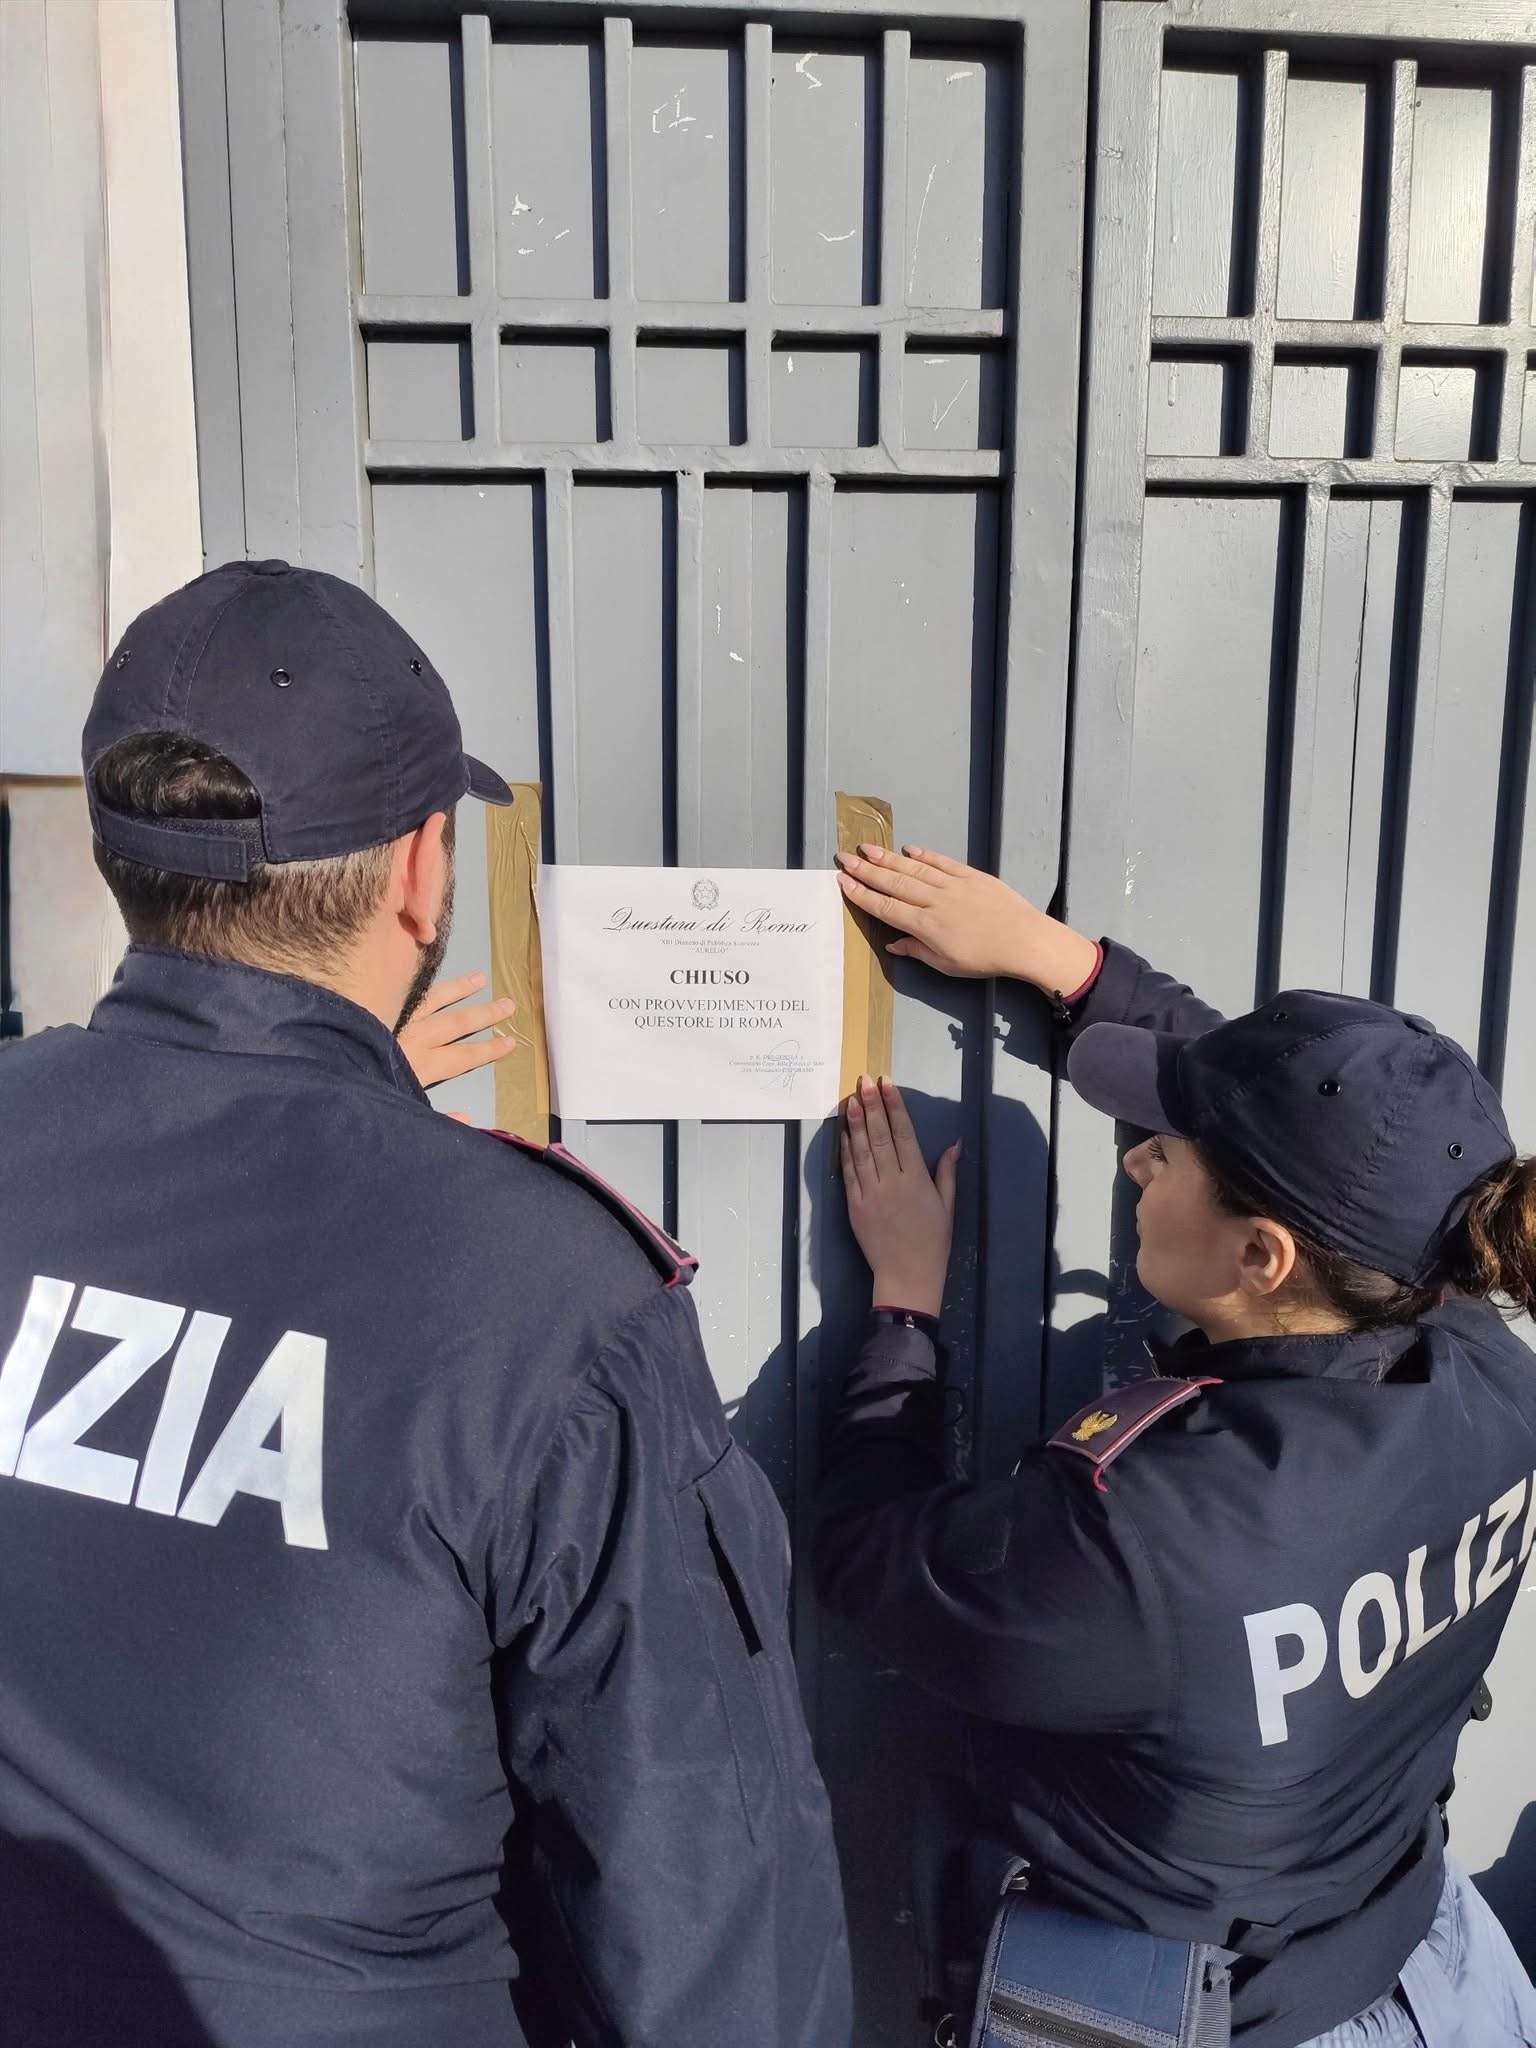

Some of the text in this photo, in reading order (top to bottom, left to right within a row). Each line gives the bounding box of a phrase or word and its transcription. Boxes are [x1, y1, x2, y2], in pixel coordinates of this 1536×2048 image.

[602, 906, 816, 934] Questura di Roma
[669, 969, 750, 985] CHIUSO
[608, 998, 810, 1012] CON PROVVEDIMENTO DEL
[634, 1015, 784, 1029] QUESTORE DI ROMA
